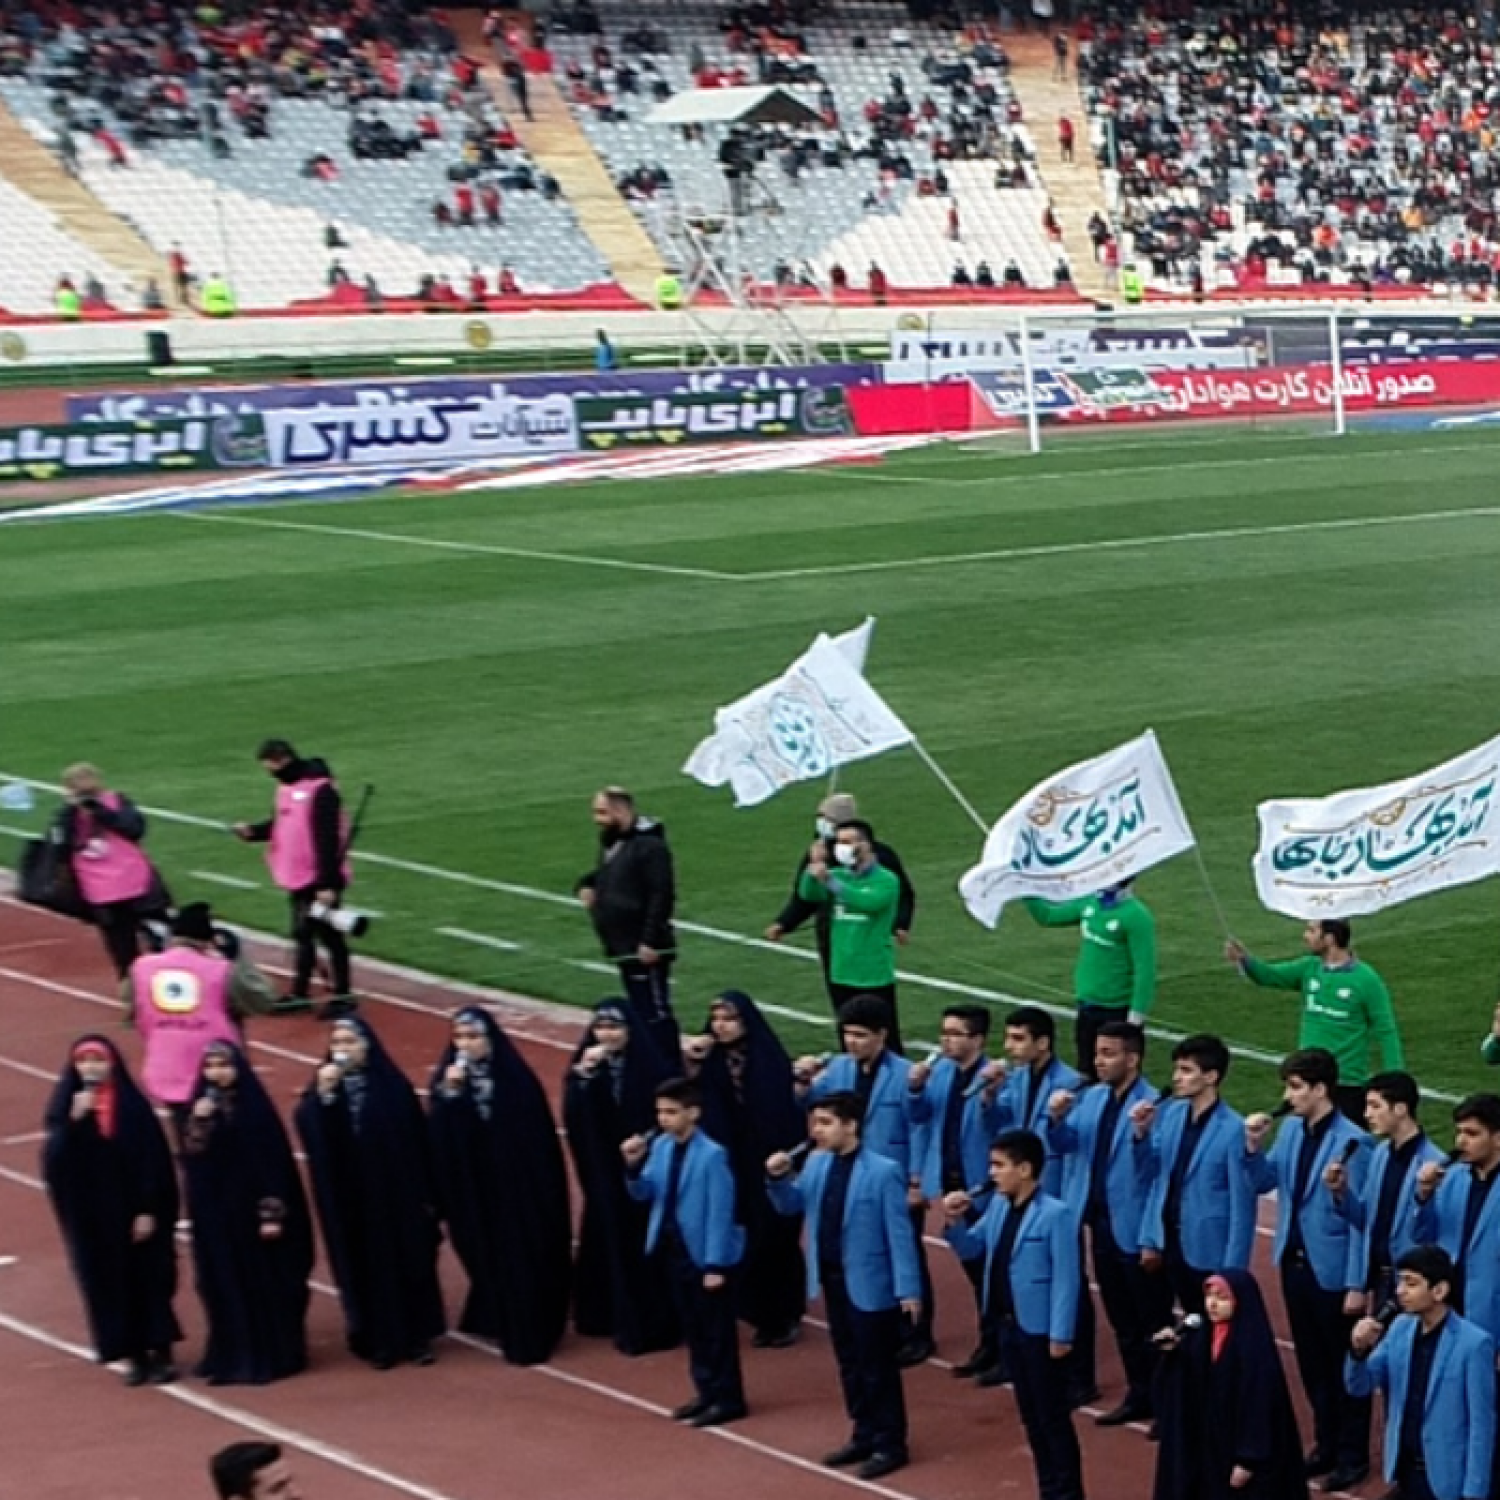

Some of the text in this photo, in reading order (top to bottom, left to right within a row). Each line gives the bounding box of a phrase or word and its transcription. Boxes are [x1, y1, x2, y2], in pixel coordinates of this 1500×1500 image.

[1255, 370, 1309, 406] کارت
[1313, 367, 1373, 404] آنلان
[1376, 373, 1436, 401] صدور
[580, 391, 796, 448] ایزی پایپ
[63, 418, 206, 467] ایزی
